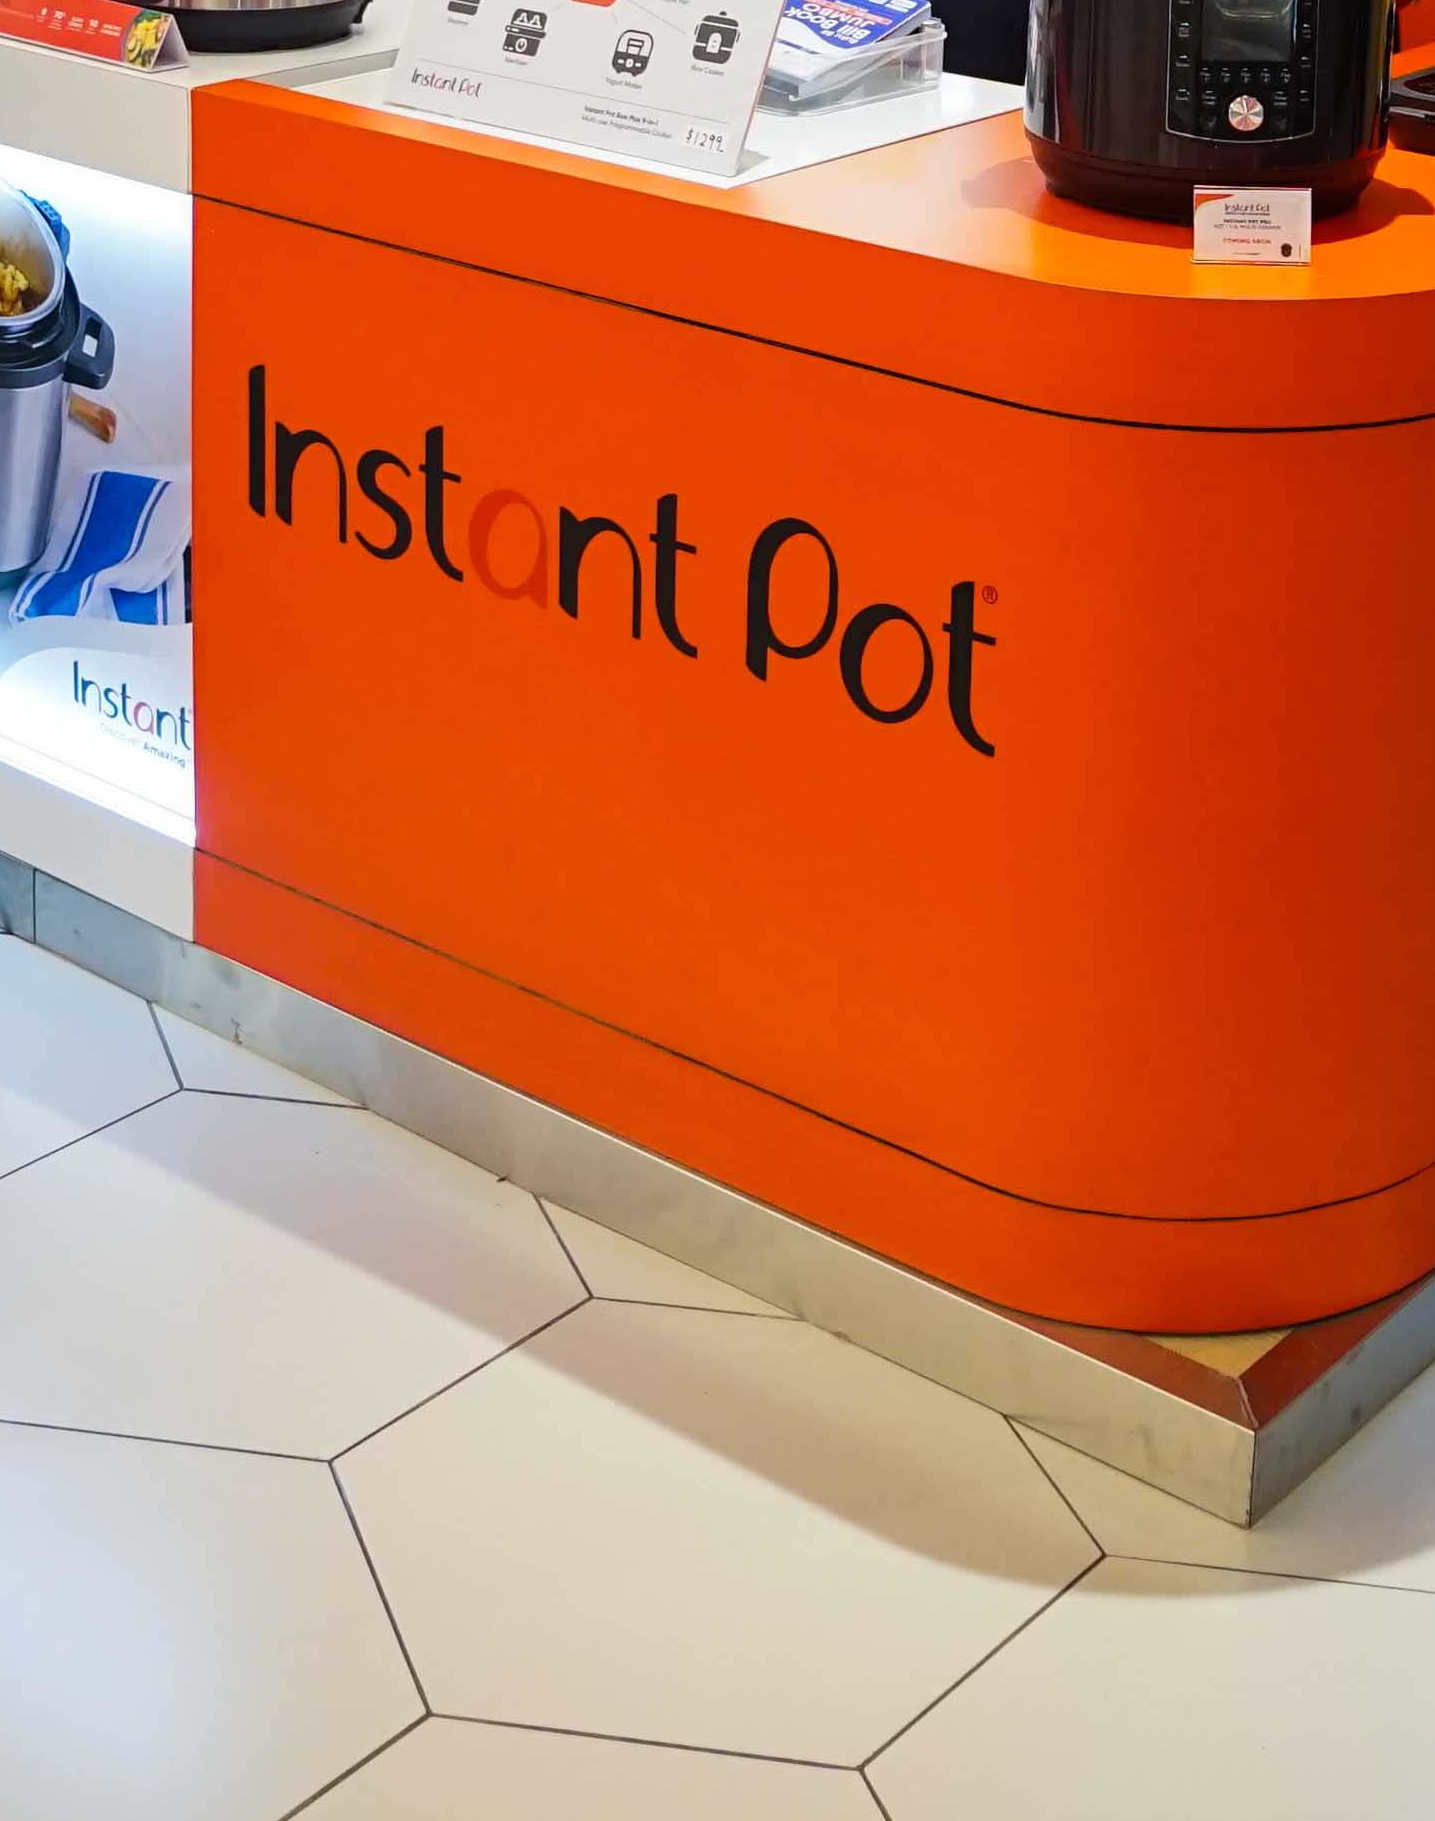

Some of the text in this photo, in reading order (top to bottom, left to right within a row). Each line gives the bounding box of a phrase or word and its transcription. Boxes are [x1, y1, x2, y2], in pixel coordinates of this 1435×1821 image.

[802, 2, 876, 28] JUMBO
[411, 68, 483, 99] Instant Pot
[247, 364, 699, 660] Instant
[73, 660, 191, 751] Instant
